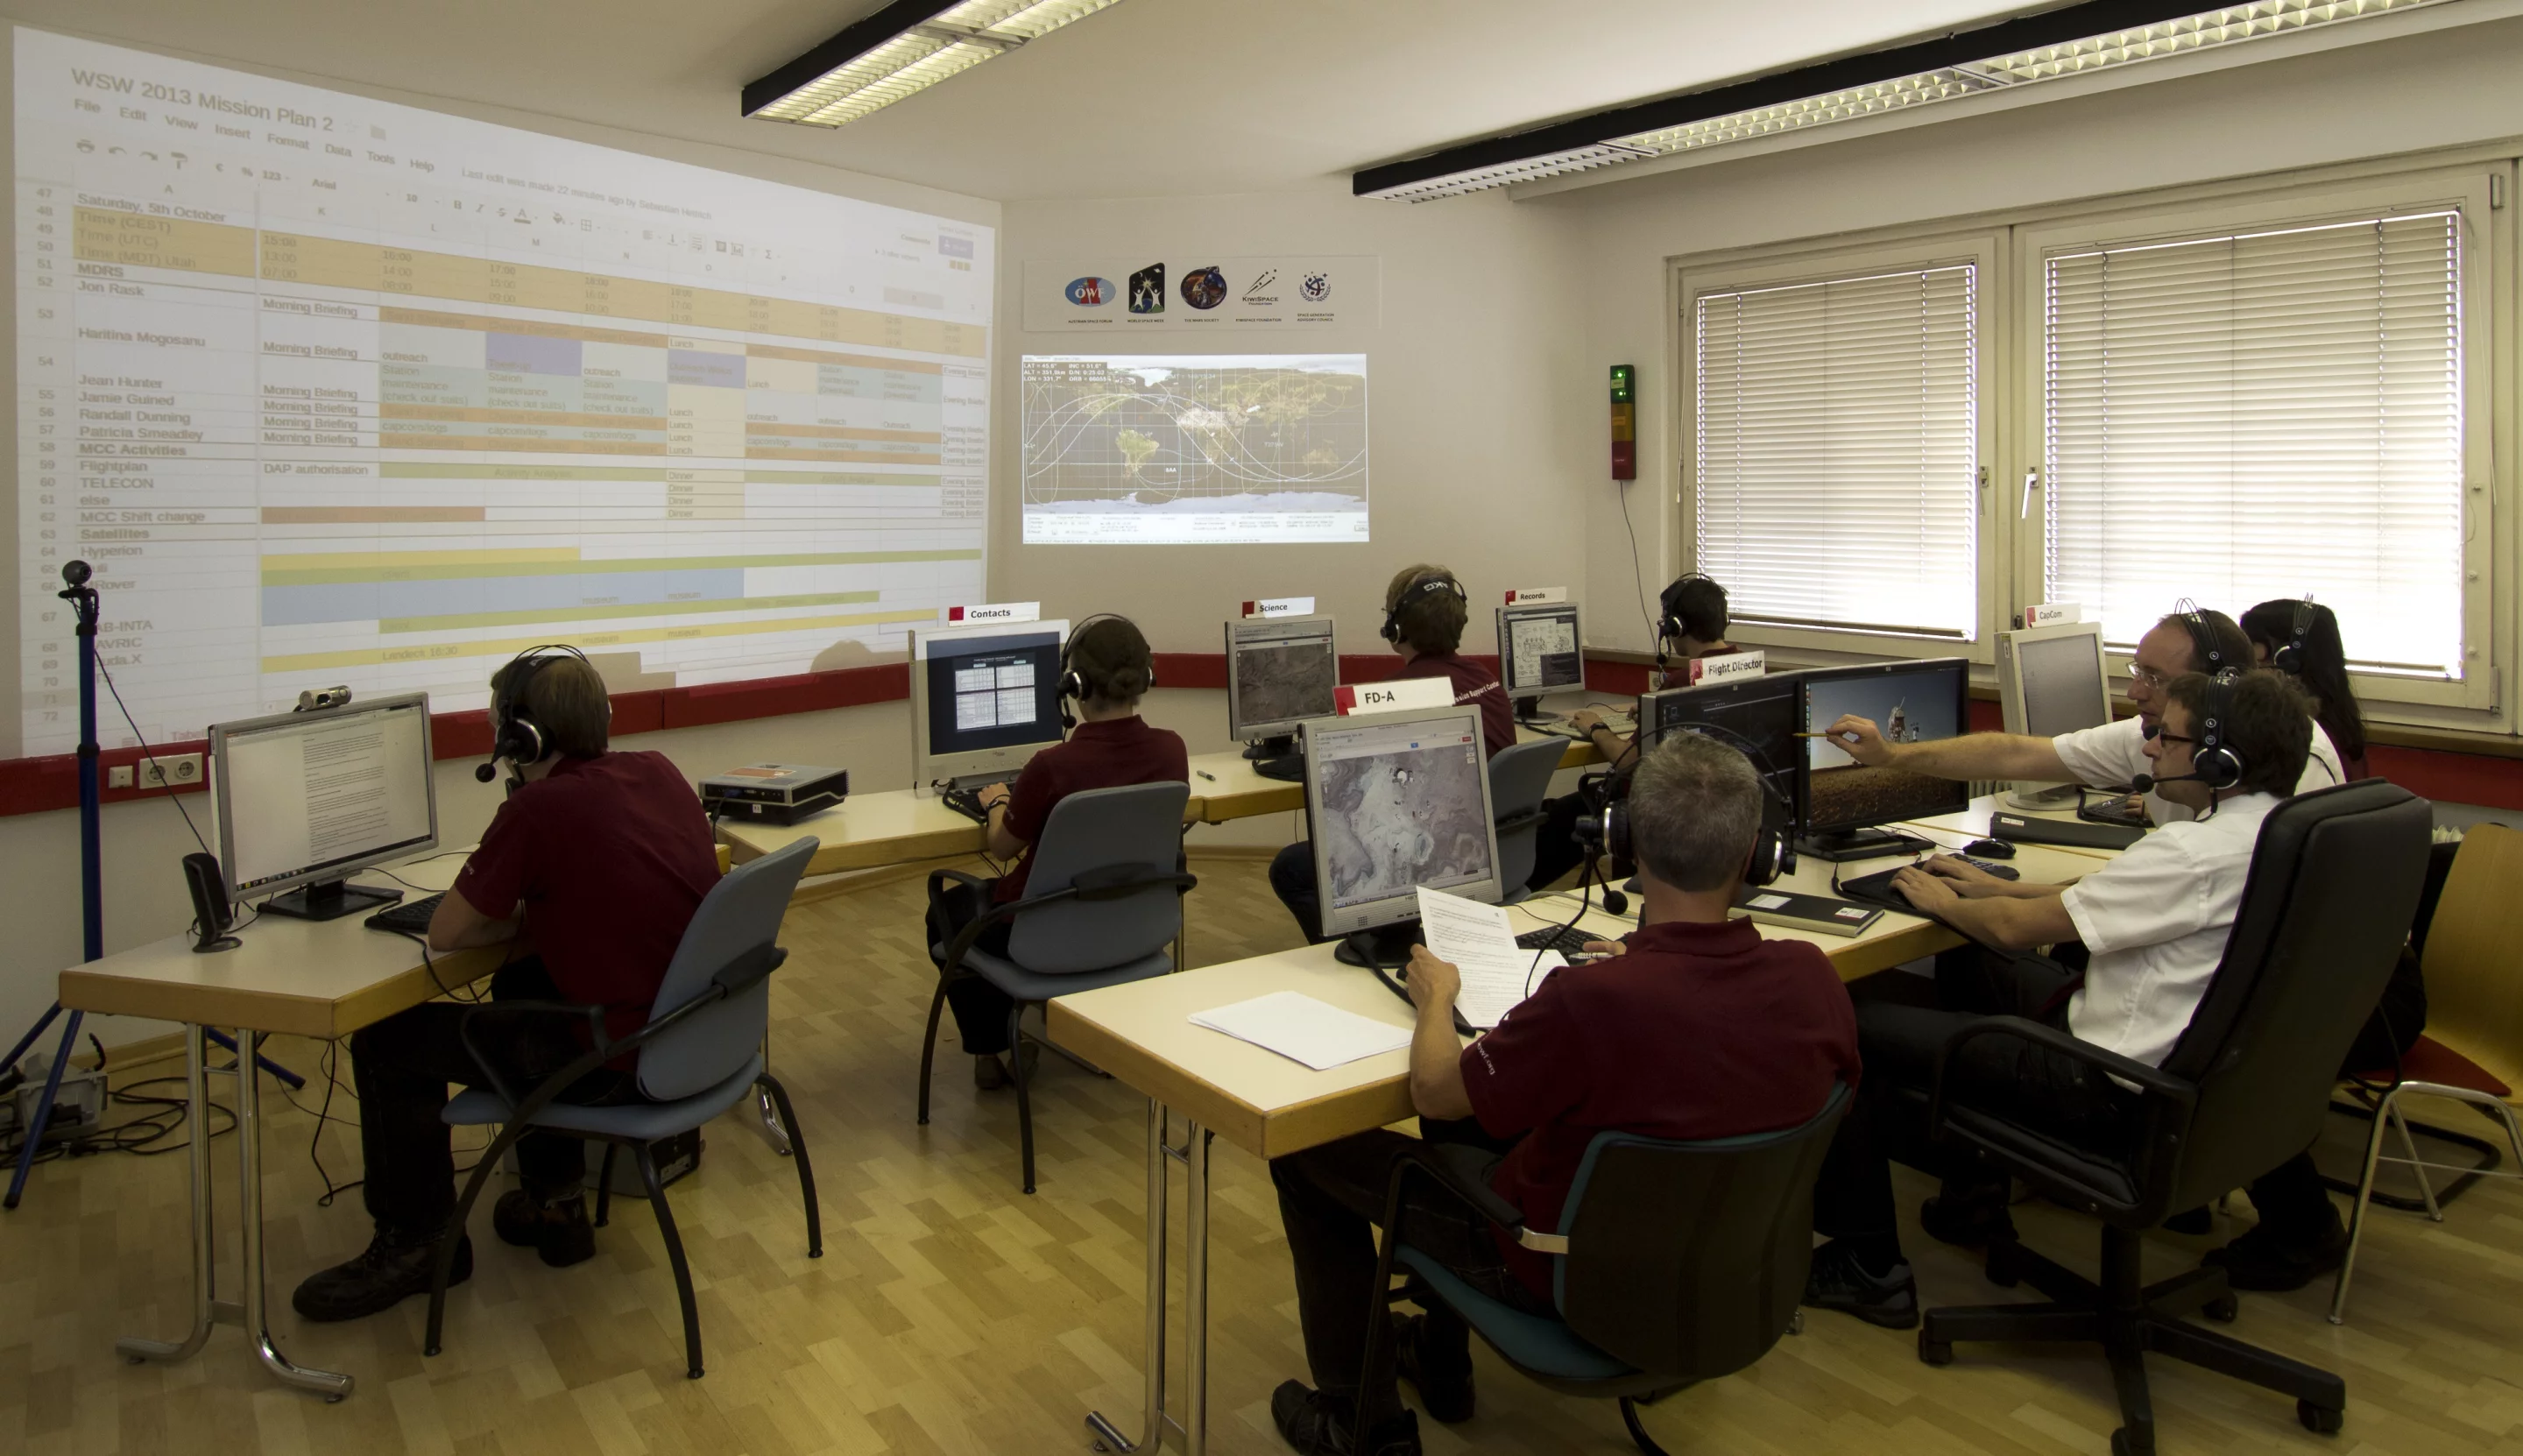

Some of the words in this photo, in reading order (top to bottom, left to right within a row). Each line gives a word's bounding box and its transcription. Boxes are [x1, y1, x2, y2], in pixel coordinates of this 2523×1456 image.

[72, 67, 134, 95] WSW
[142, 81, 191, 104] 2013
[199, 92, 270, 120] Mission
[277, 107, 316, 130] Plan
[322, 116, 333, 131] 2
[74, 98, 101, 115] File
[119, 107, 146, 123] Edit
[165, 115, 198, 131] View
[215, 124, 251, 141] Insert
[267, 132, 309, 152] Format
[325, 143, 352, 158] Data
[367, 151, 395, 166] Tools
[410, 157, 435, 173] Help
[77, 193, 143, 216] Saturday,
[148, 202, 171, 219] 5th
[174, 205, 227, 223] October
[77, 210, 115, 230] Time
[120, 214, 172, 234] (CEST)
[118, 231, 159, 250] (UTC)
[118, 252, 160, 267] (MDT)
[77, 263, 124, 278] MDRS
[77, 280, 105, 293] Jon
[109, 283, 145, 297] Rask
[1074, 285, 1105, 299] ÖWF
[263, 298, 311, 315] Morning
[314, 303, 358, 319] Briefing
[137, 331, 206, 348] Mogosanu
[264, 342, 311, 357] Morning
[314, 345, 358, 361] Briefing
[382, 352, 428, 362] outreach
[38, 357, 54, 366] 54
[383, 365, 420, 376] Station
[78, 374, 114, 386] Jean
[118, 376, 163, 389] Hunter
[78, 392, 122, 404] Jamie
[314, 387, 357, 401] Briefing
[314, 403, 357, 416] Briefing
[79, 408, 131, 421] Randall
[137, 411, 191, 426] Dunning
[80, 425, 133, 438] Patricia
[314, 418, 357, 432] Briefing
[314, 434, 357, 447] Briefing
[80, 443, 116, 455] MCC
[120, 444, 187, 456] Activities
[80, 460, 148, 474] Flightplan
[264, 463, 292, 474] DAP
[295, 464, 369, 476] authorisation
[81, 477, 154, 489] TELECON
[80, 494, 110, 505] else
[80, 512, 117, 523] MCC
[121, 511, 153, 522] Shift
[157, 512, 206, 523] change
[81, 545, 143, 559] Hyperion
[971, 609, 1011, 618] Contacts
[1259, 604, 1288, 612] Science
[2039, 611, 2062, 620] CapCom
[1708, 663, 1730, 676] Flight
[1733, 659, 1763, 672] Director
[1365, 690, 1396, 704] FD-A
